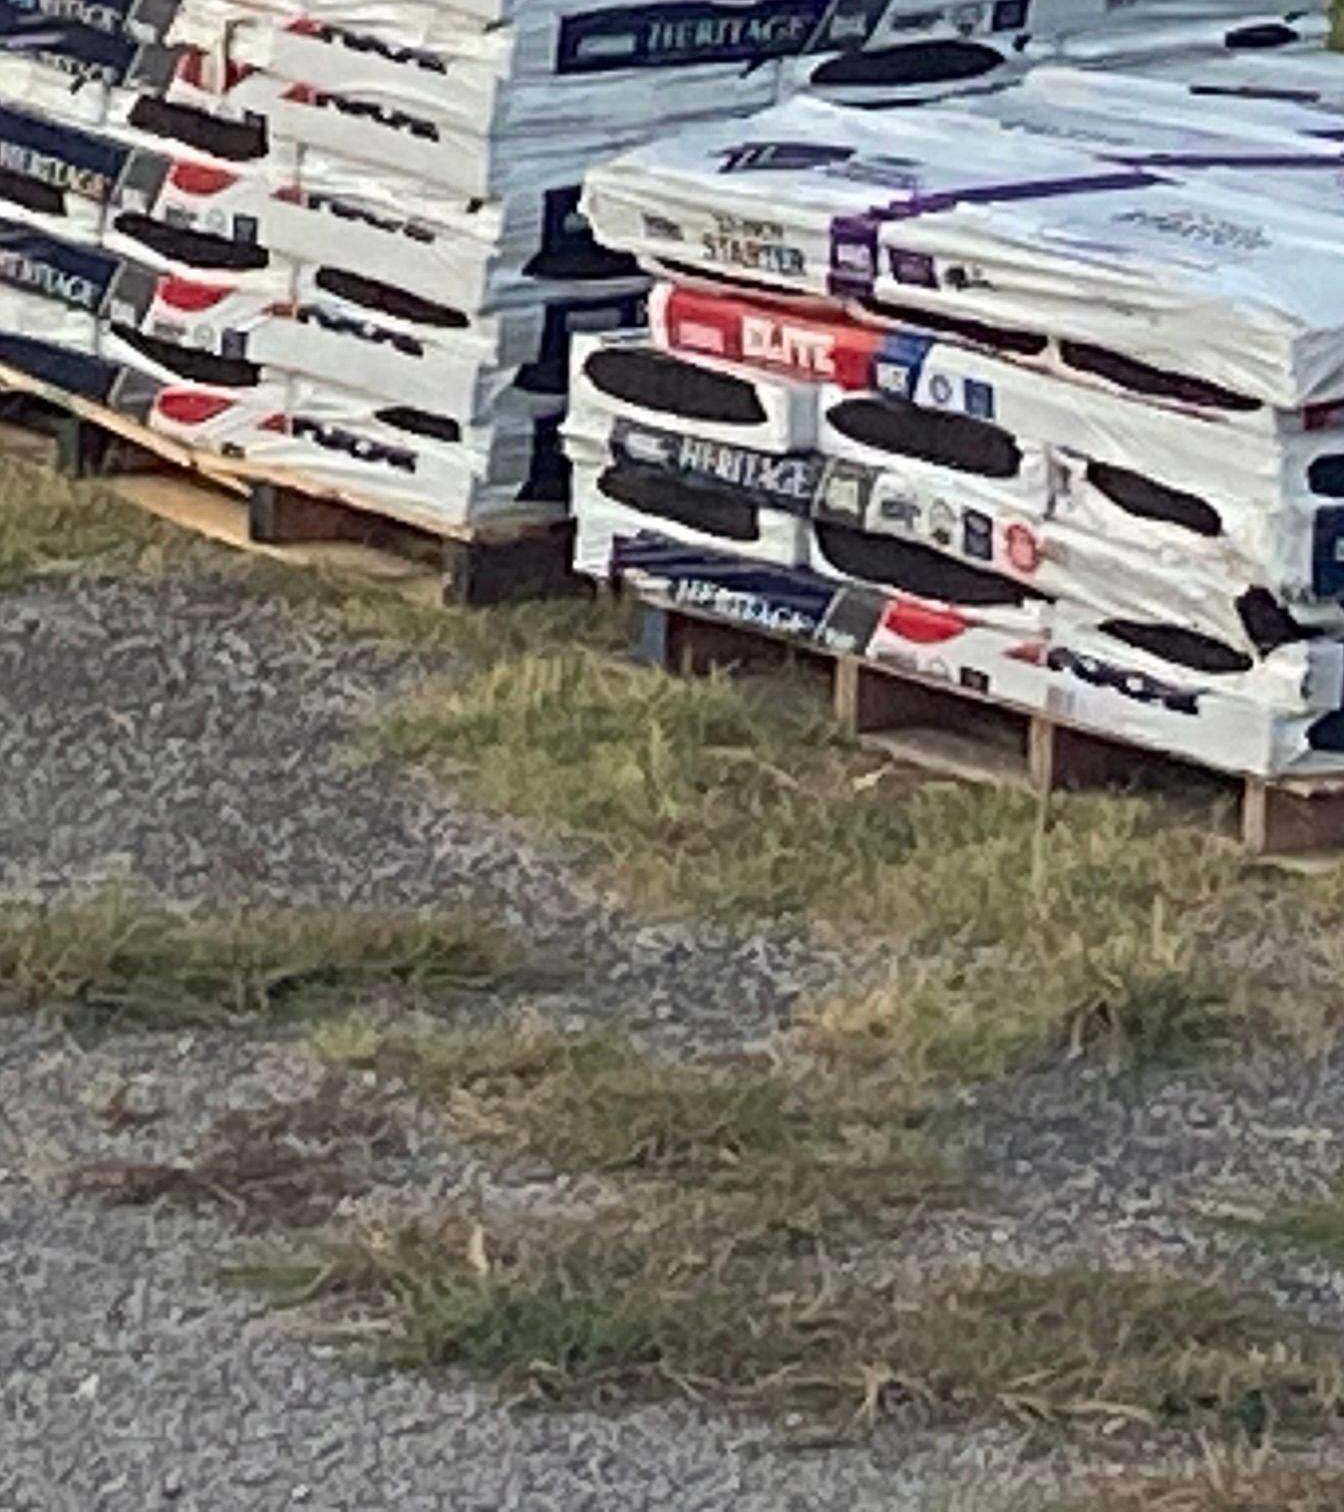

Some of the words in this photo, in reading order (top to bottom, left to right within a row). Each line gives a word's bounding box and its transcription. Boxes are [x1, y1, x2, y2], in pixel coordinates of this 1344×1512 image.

[644, 14, 808, 52] HERITAGE
[700, 231, 807, 277] STARTER
[742, 315, 835, 376] ELITE
[677, 436, 813, 500] HERITAGE
